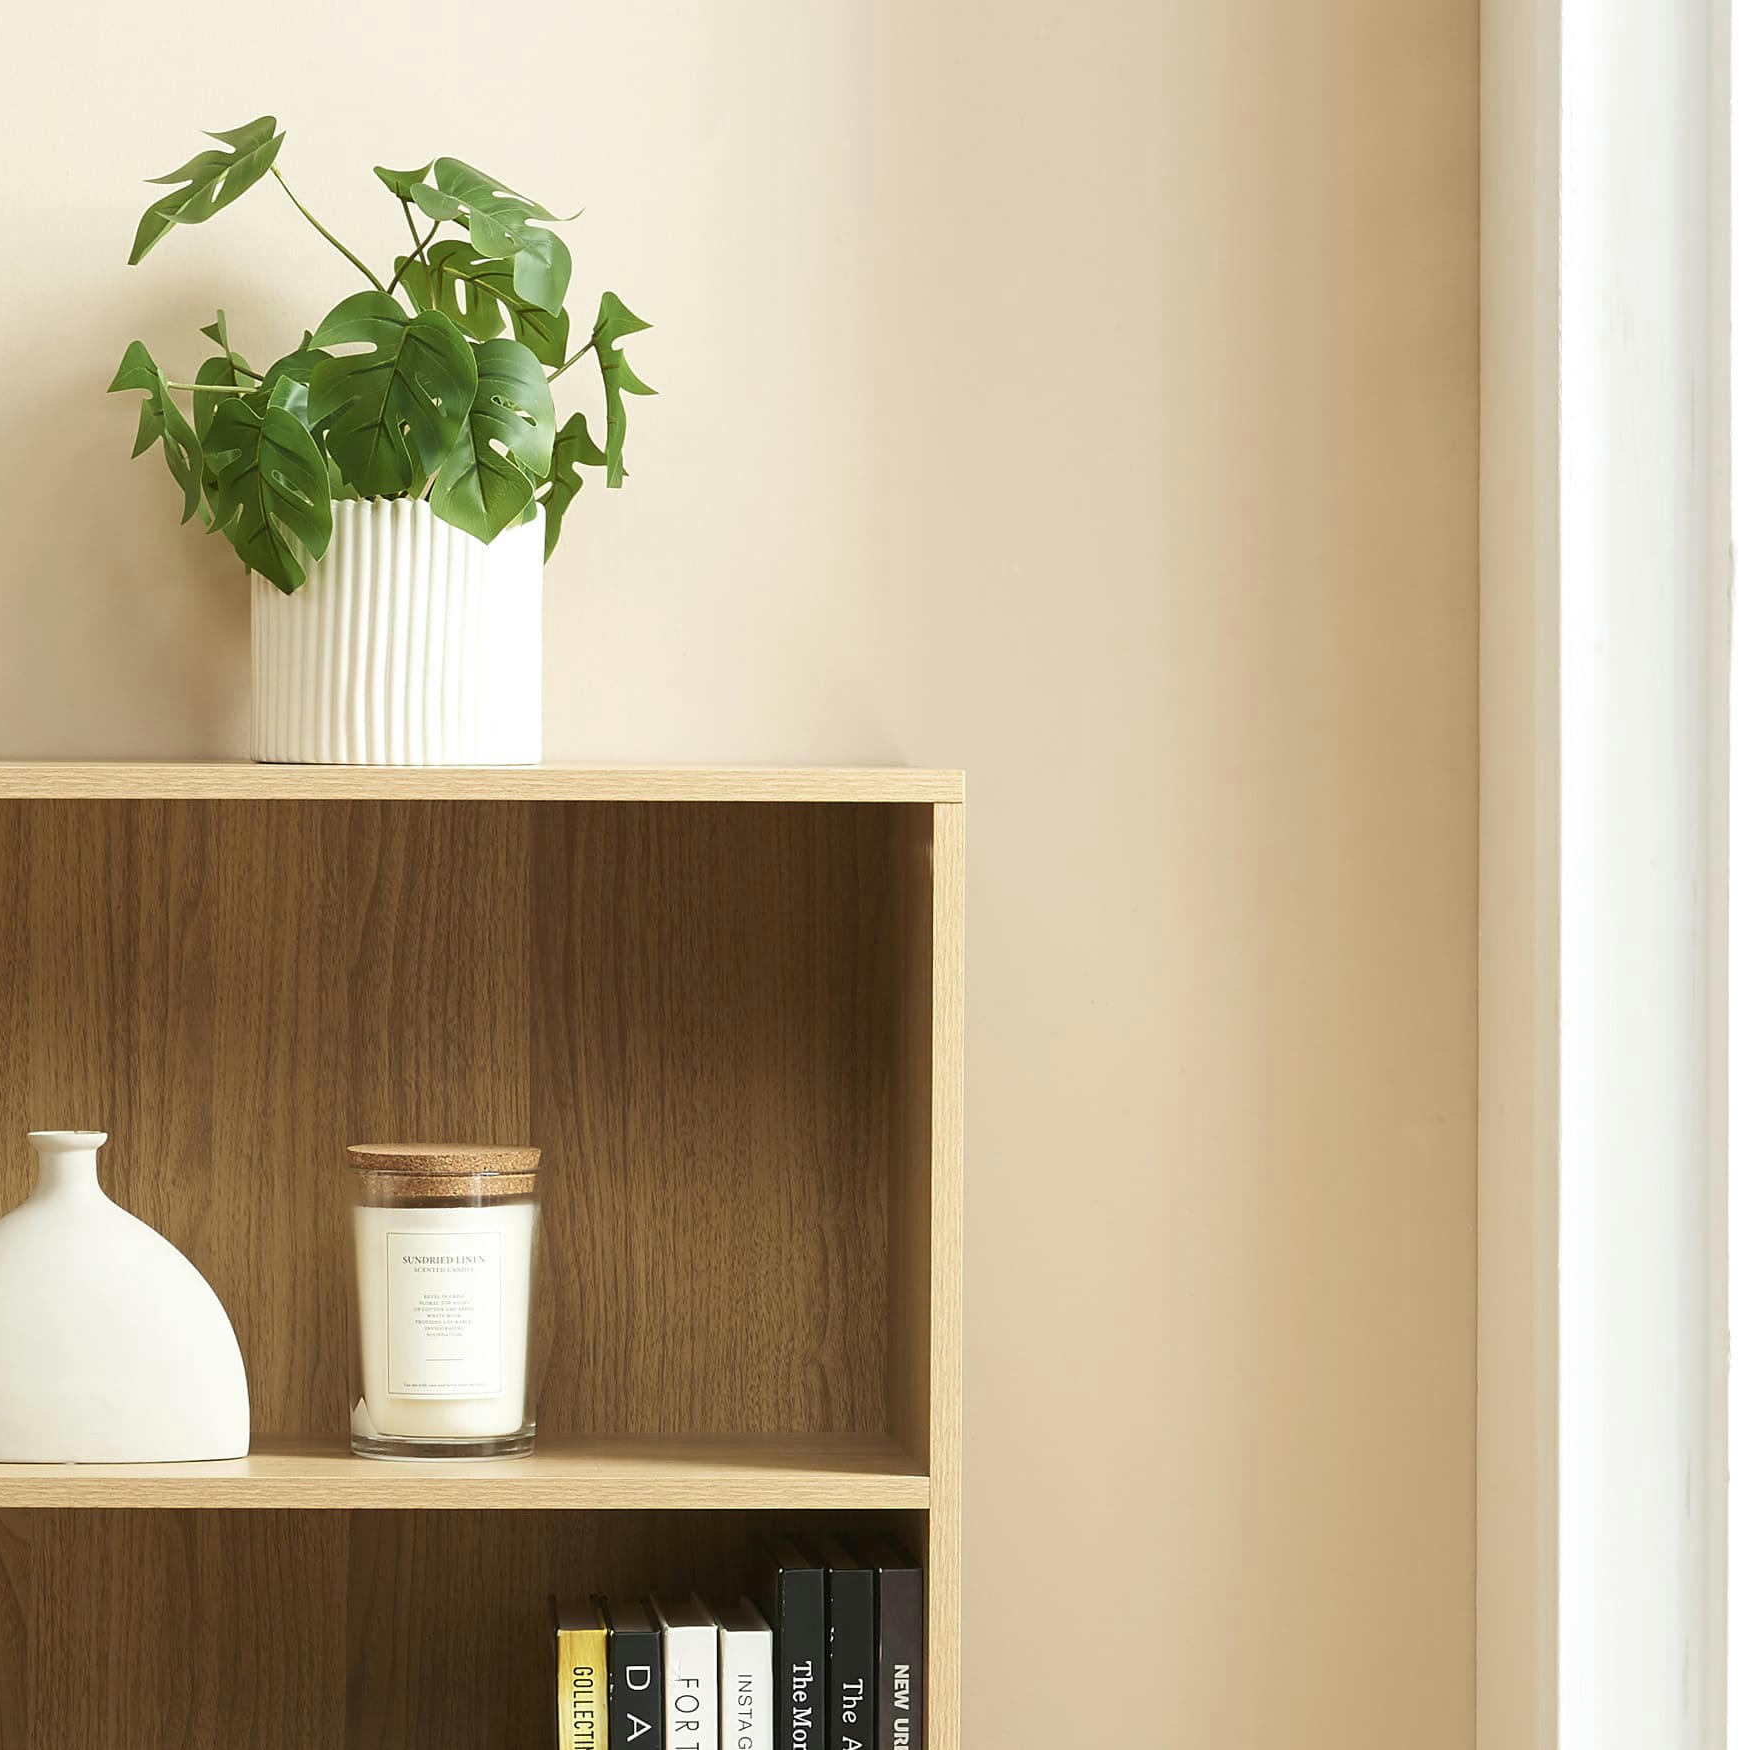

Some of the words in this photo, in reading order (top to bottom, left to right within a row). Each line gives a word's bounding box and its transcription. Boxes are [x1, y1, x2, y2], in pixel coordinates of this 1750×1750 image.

[402, 1256, 454, 1264] SUNDRIED
[674, 1678, 700, 1732] FOR
[792, 1661, 813, 1703] The
[842, 1678, 864, 1724] The
[893, 1664, 910, 1710] NEW
